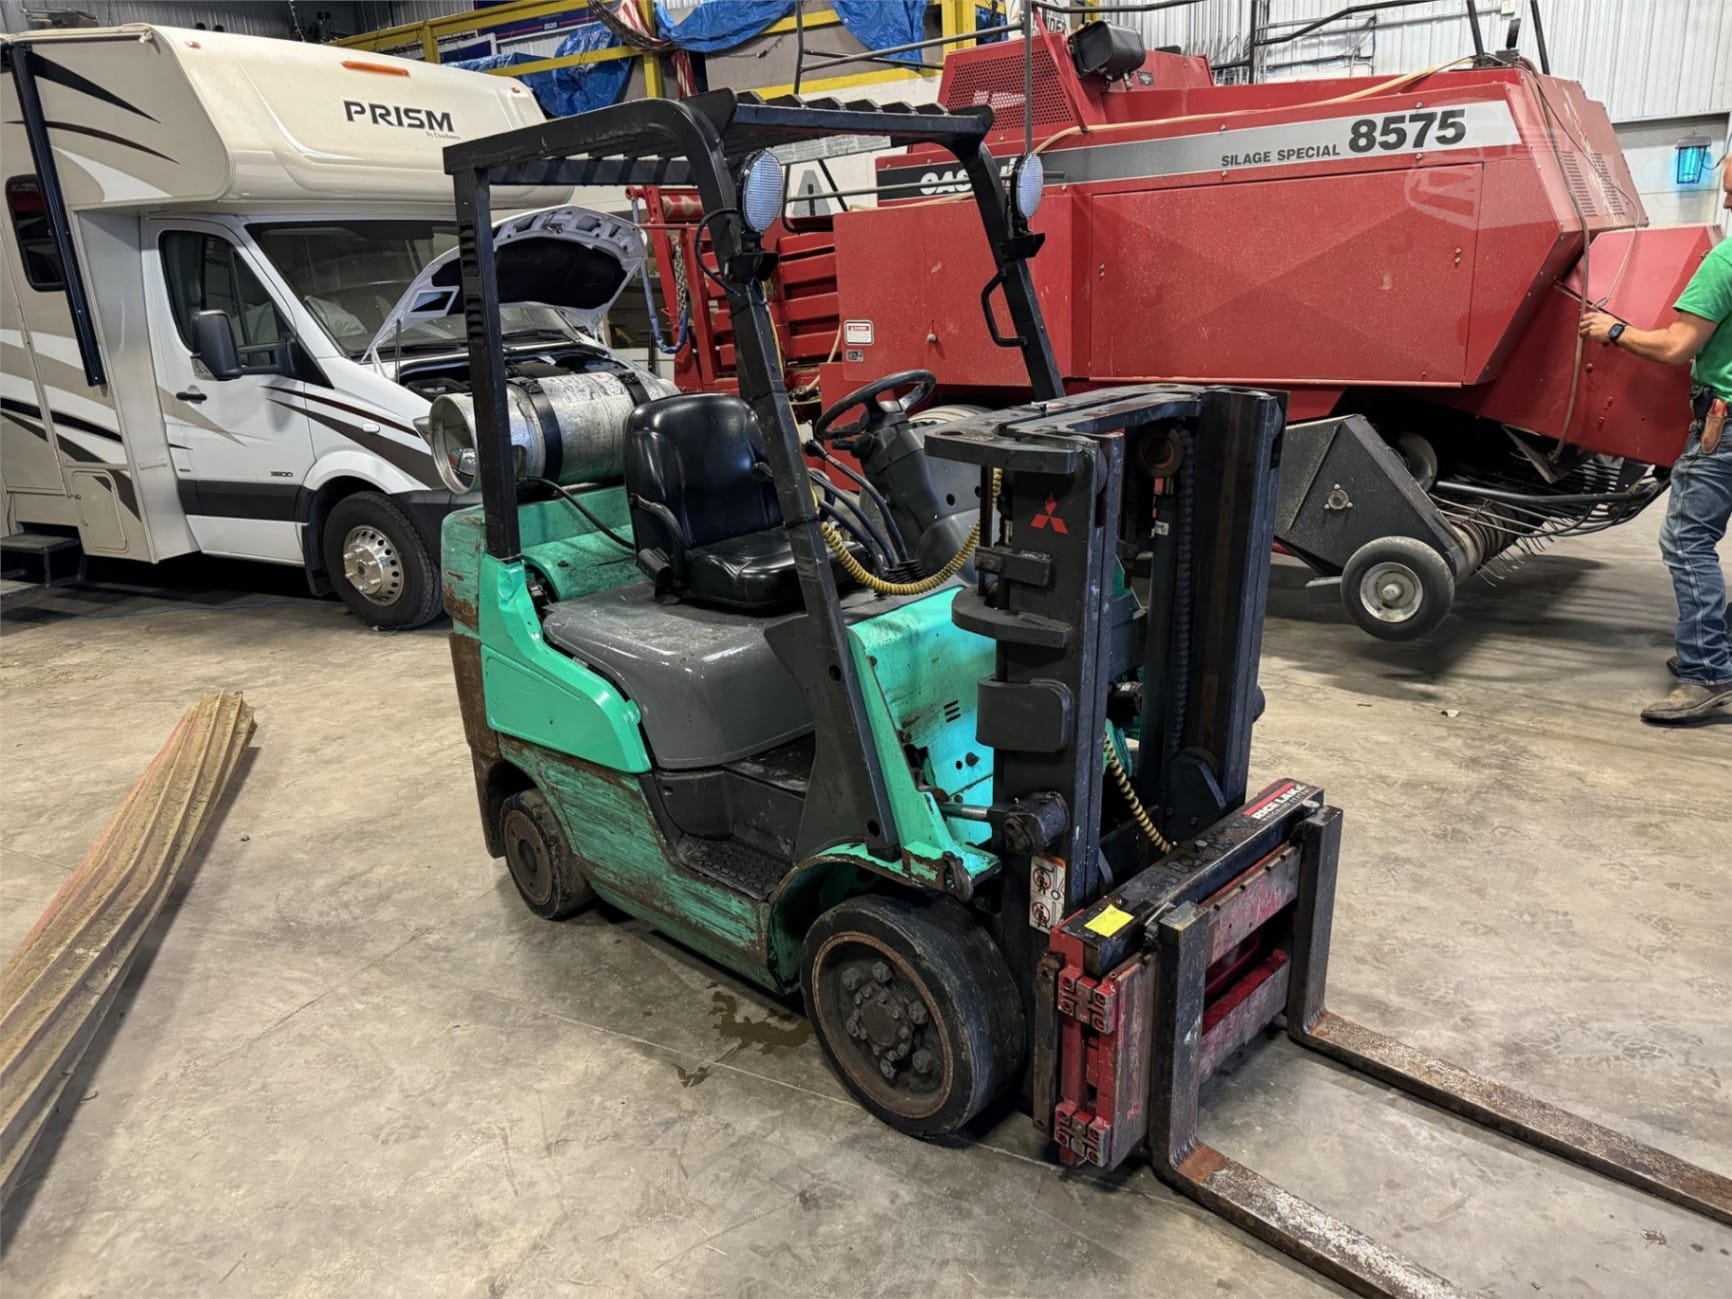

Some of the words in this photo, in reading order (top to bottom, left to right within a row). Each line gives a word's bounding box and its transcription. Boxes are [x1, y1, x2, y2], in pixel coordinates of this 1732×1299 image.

[343, 100, 454, 133] PRISM
[1221, 150, 1272, 167] SILAGE
[1276, 144, 1341, 162] SPECIAL
[1348, 109, 1467, 153] 8575
[919, 168, 973, 196] CAS
